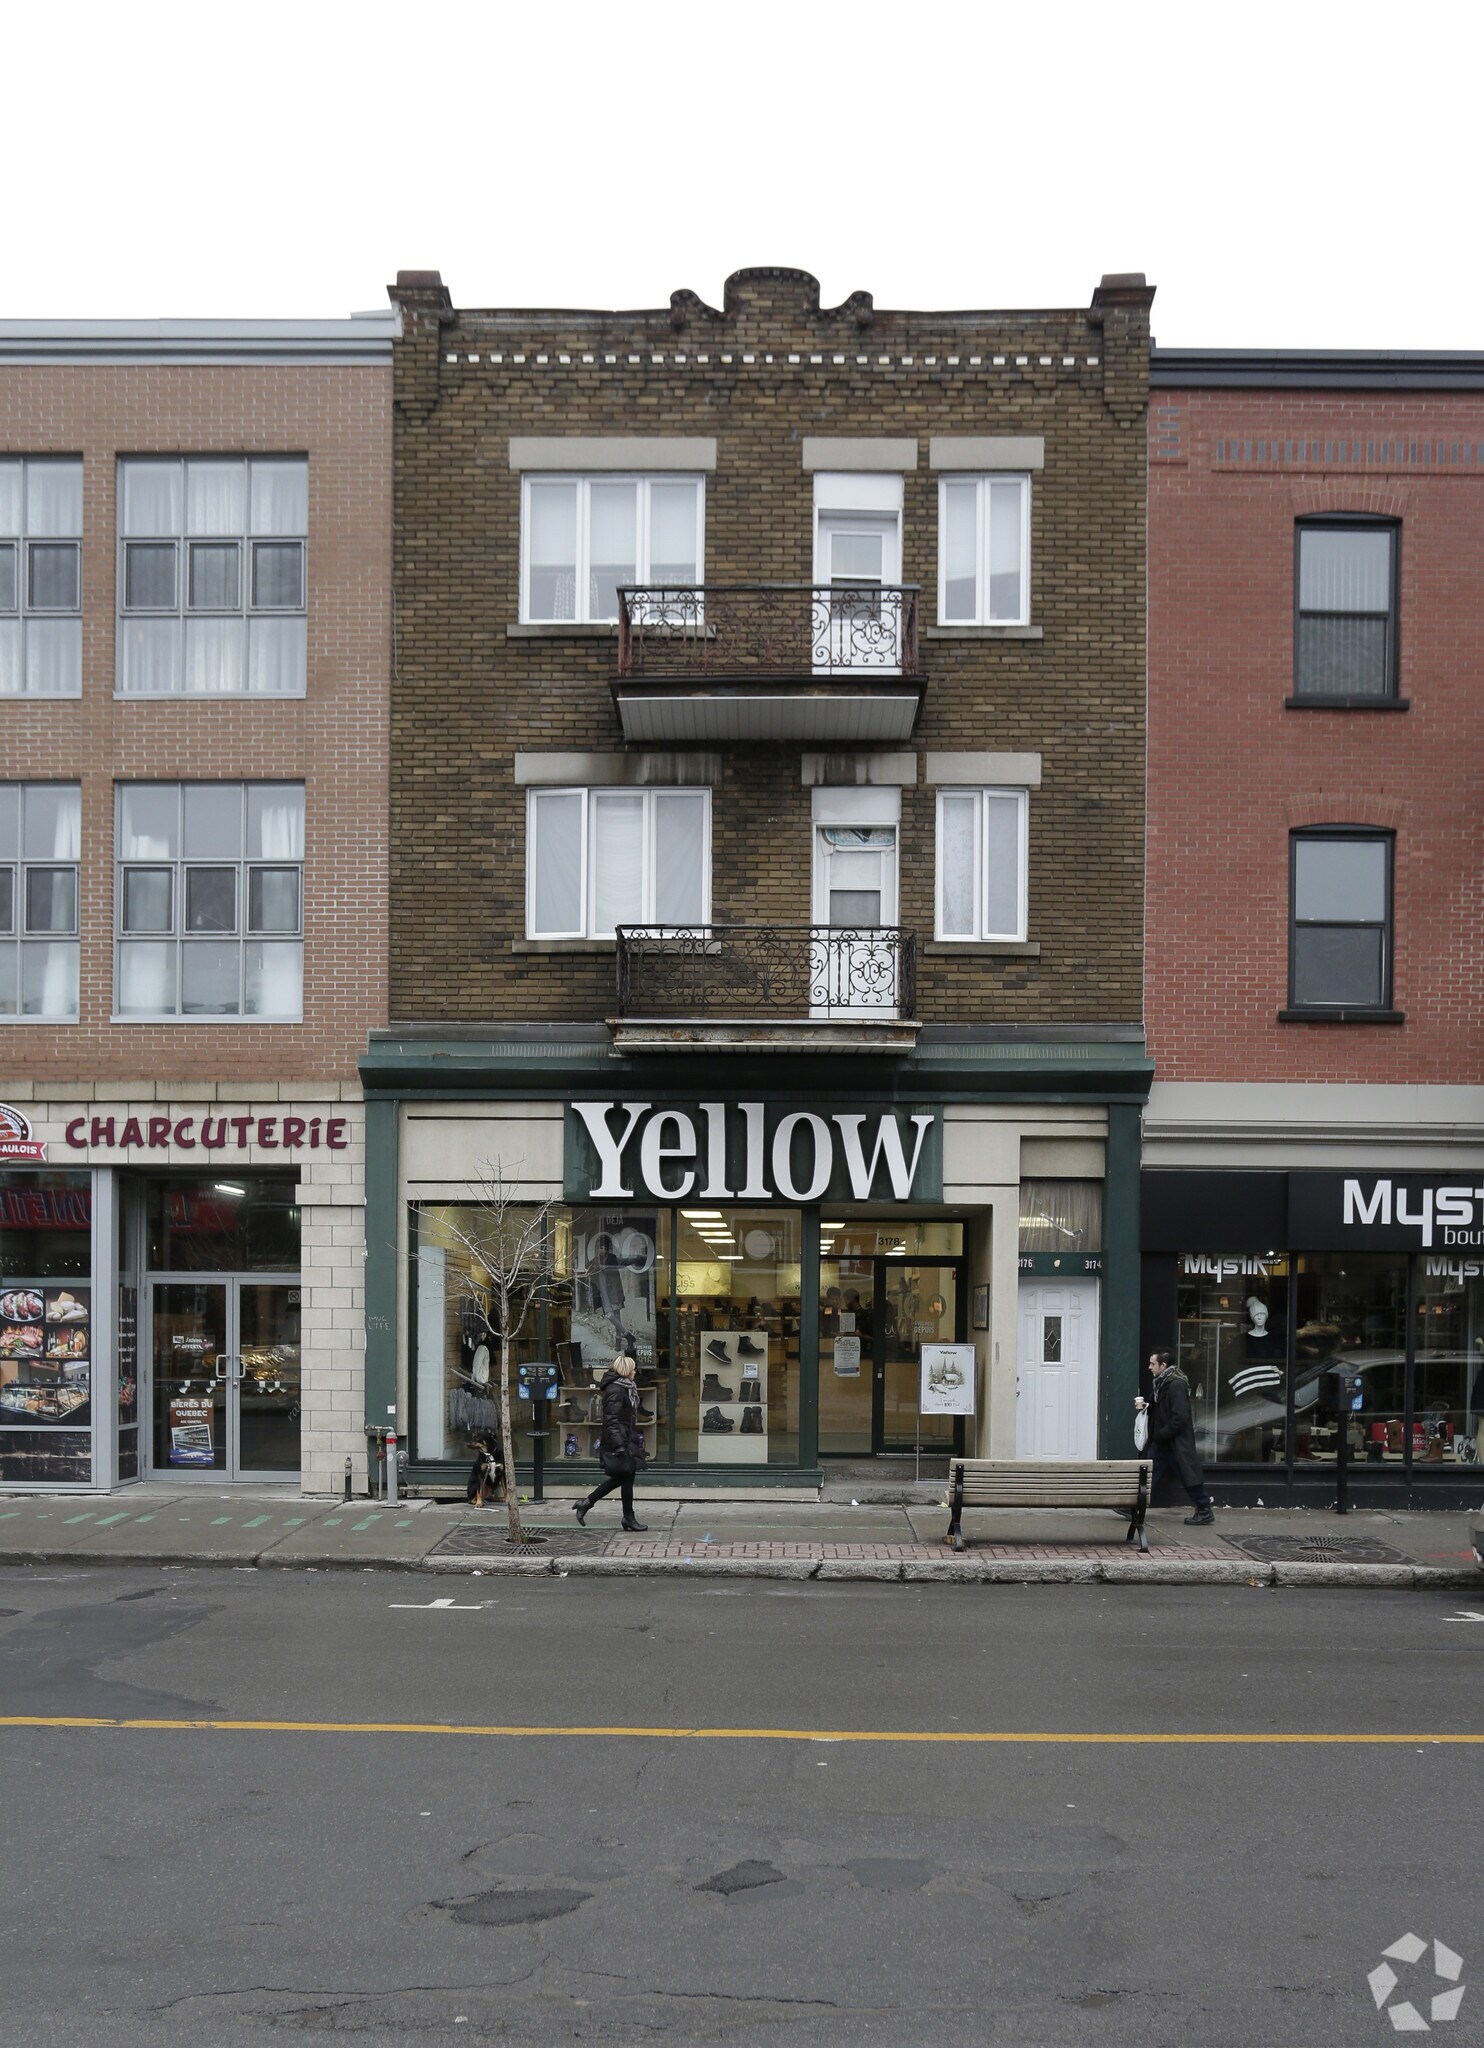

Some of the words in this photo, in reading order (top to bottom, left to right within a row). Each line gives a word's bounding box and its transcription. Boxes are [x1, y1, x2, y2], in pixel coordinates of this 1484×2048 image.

[0, 1144, 38, 1155] AULOIS
[571, 1102, 934, 1201] Yellow
[878, 1237, 900, 1246] 3178
[1084, 1260, 1102, 1269] 3174
[1426, 1256, 1484, 1285] Mys
